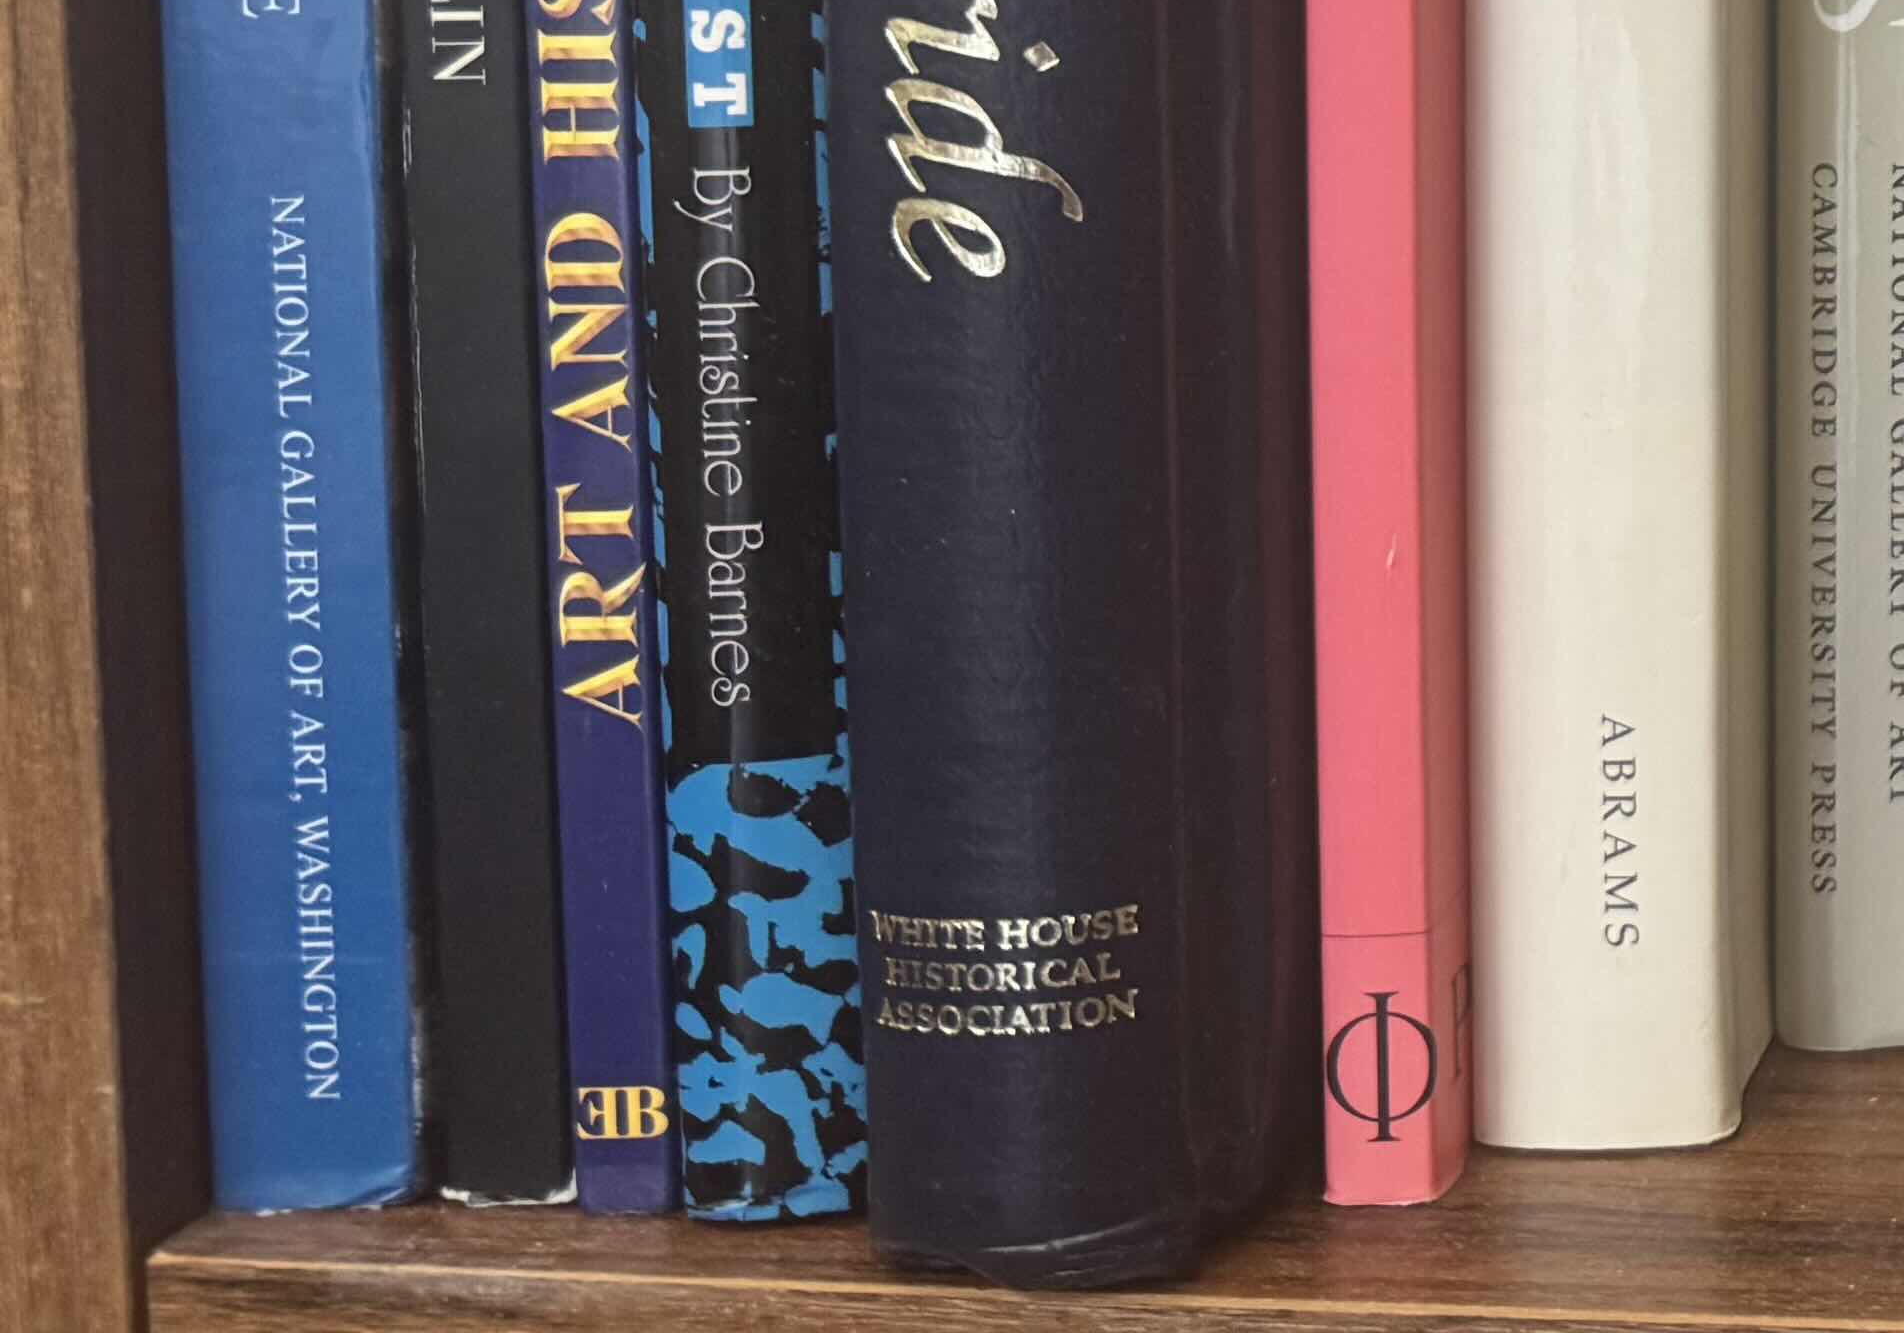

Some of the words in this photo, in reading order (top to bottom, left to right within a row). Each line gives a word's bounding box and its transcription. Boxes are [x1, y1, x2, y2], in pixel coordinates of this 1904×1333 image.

[268, 194, 313, 418] NATIONAL
[673, 165, 752, 251] By
[1810, 161, 1840, 438] CAMBRIDGE
[544, 209, 636, 455] AND
[694, 254, 757, 500] Christine
[277, 430, 322, 626] GALLERY
[556, 480, 648, 731] ART
[703, 521, 765, 710] Barnes
[1809, 464, 1838, 738] UNIVERSITY
[287, 641, 323, 699] OF
[287, 709, 330, 805] ART,
[1600, 713, 1641, 950] ABRAMS
[1810, 763, 1839, 895] PRESS
[294, 812, 342, 1102] WASHINGTON
[869, 909, 985, 955] WHITE
[997, 903, 1141, 952] HOUSE
[877, 988, 1139, 1038] ASSOCIATION
[884, 950, 1123, 992] HISTORICAL
